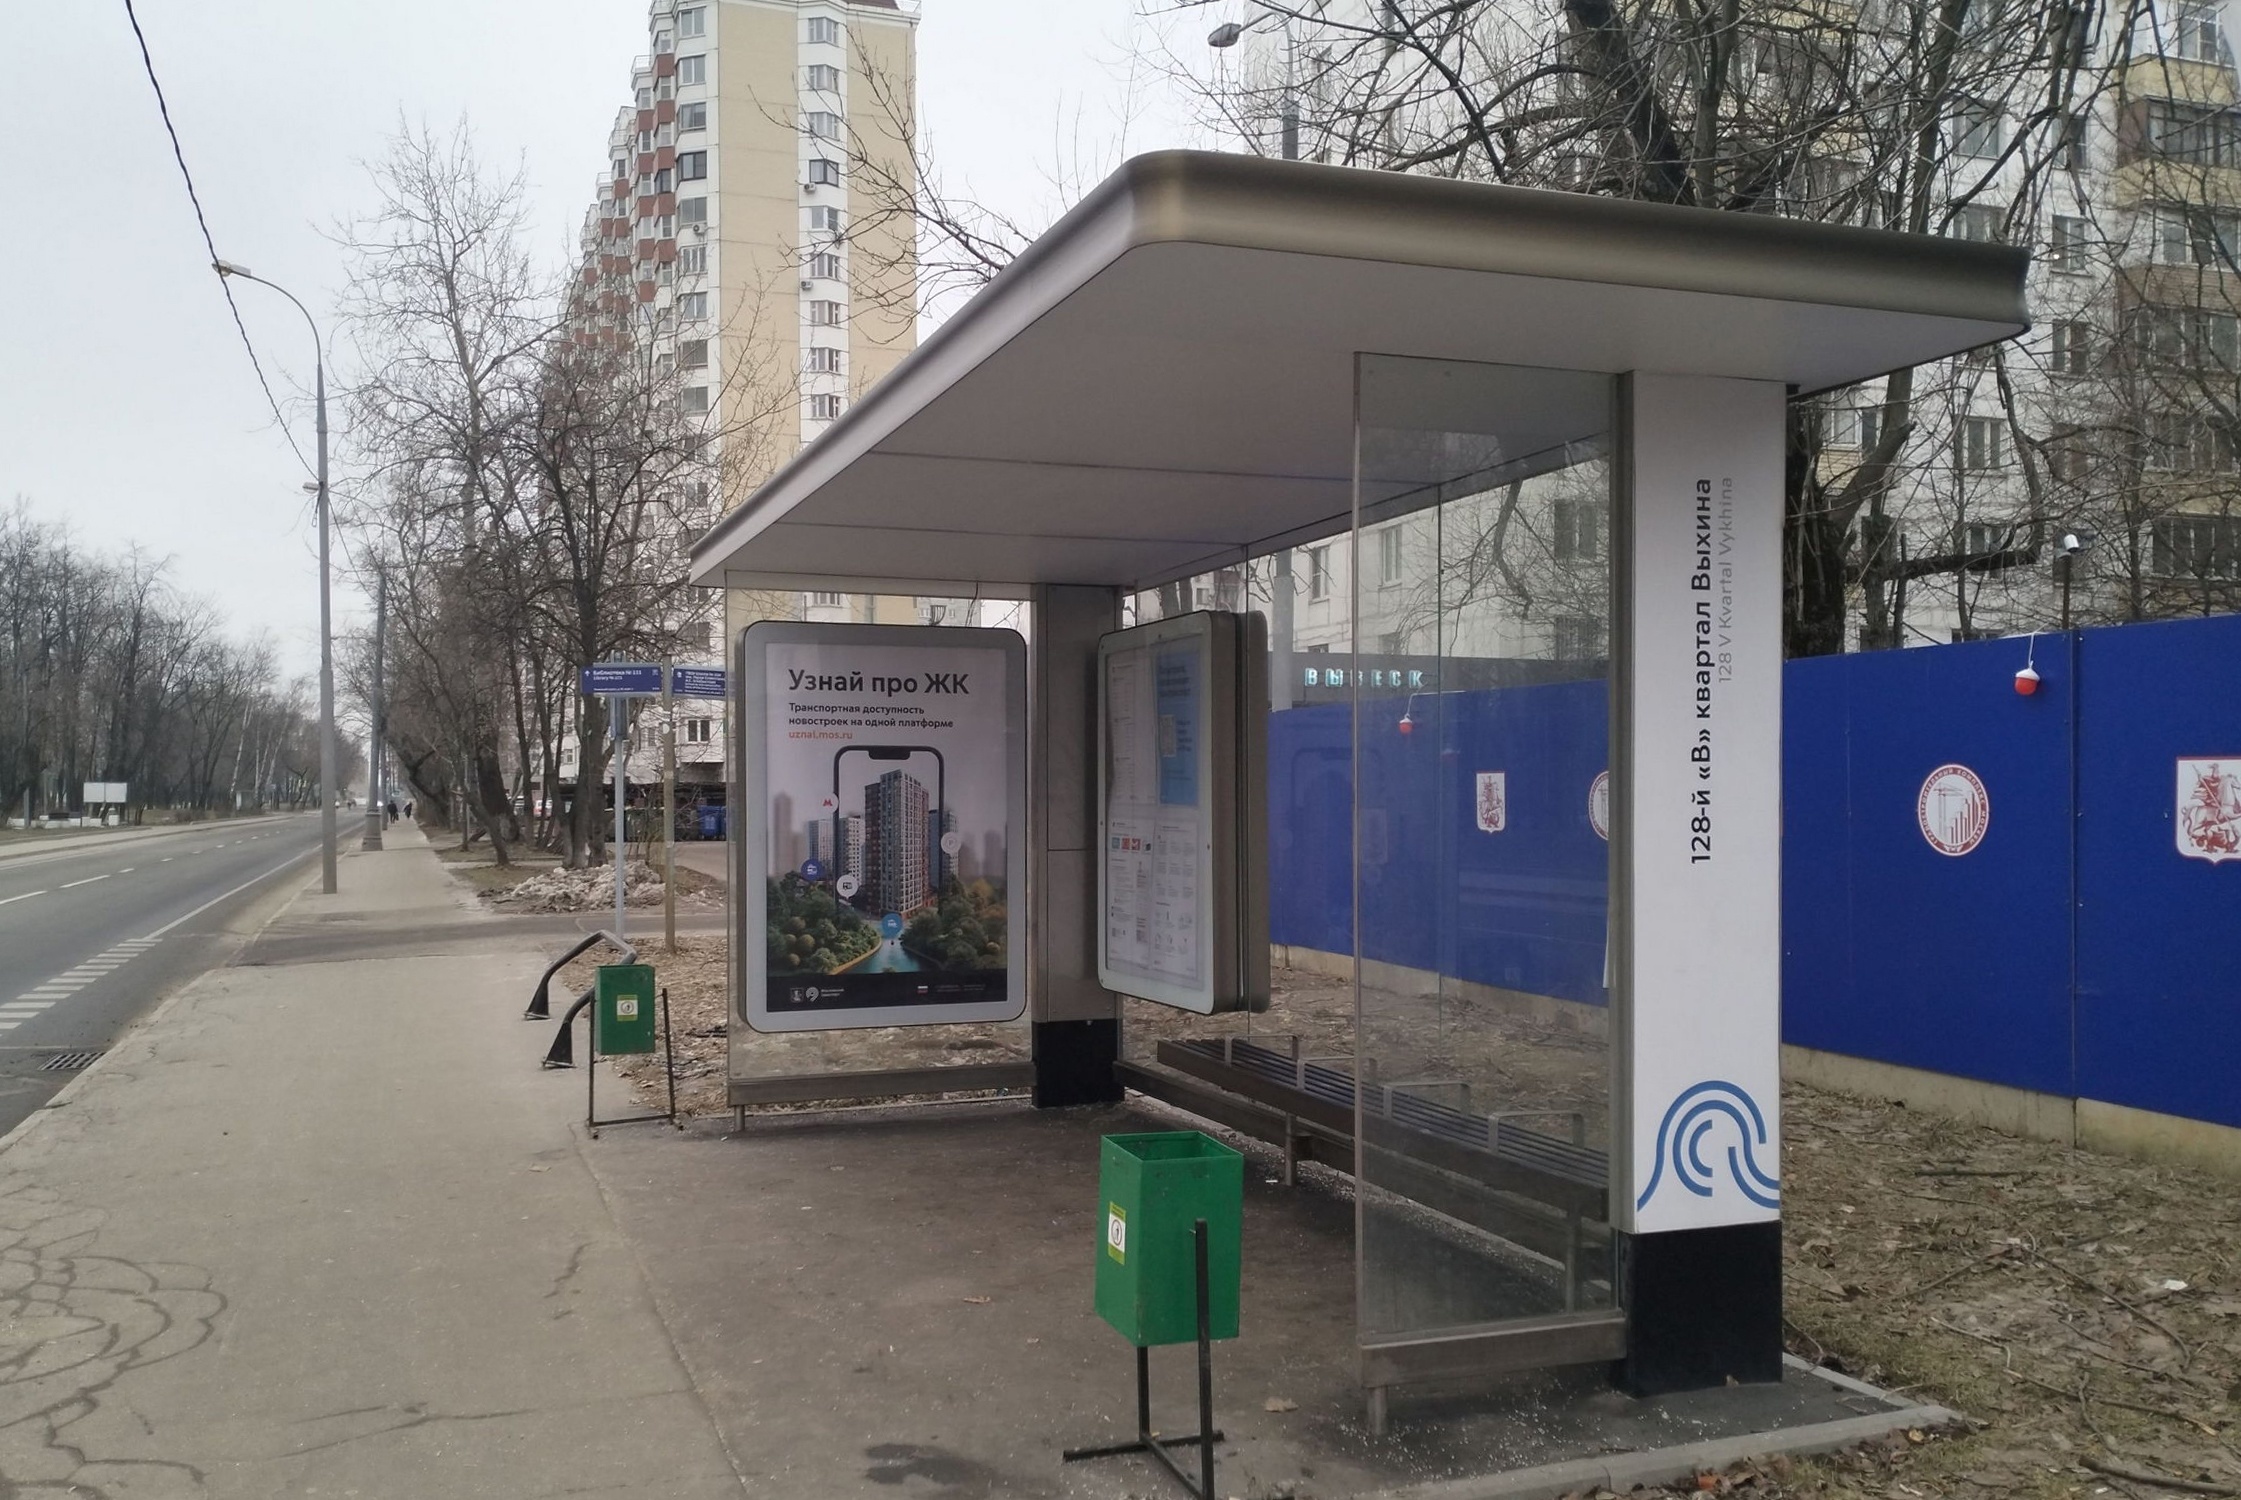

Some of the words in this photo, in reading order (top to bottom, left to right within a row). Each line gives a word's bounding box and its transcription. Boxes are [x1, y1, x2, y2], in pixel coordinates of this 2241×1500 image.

[1691, 479, 1712, 592] Выхина
[1718, 476, 1735, 555] Vykhina
[1718, 562, 1733, 630] Kvartal
[1694, 601, 1716, 719] квартал
[1718, 633, 1733, 648] V
[788, 669, 864, 692] Узнай
[872, 676, 918, 698] про
[924, 673, 970, 695] ЖК
[1718, 652, 1733, 684] 128
[788, 702, 860, 715] Транспортная
[862, 705, 925, 716] доступность
[788, 716, 849, 729] новостроек
[850, 719, 863, 727] на
[865, 717, 896, 729] одной
[898, 717, 954, 730] платформе
[1691, 727, 1712, 781] «В»
[1691, 789, 1712, 865] 128-й
